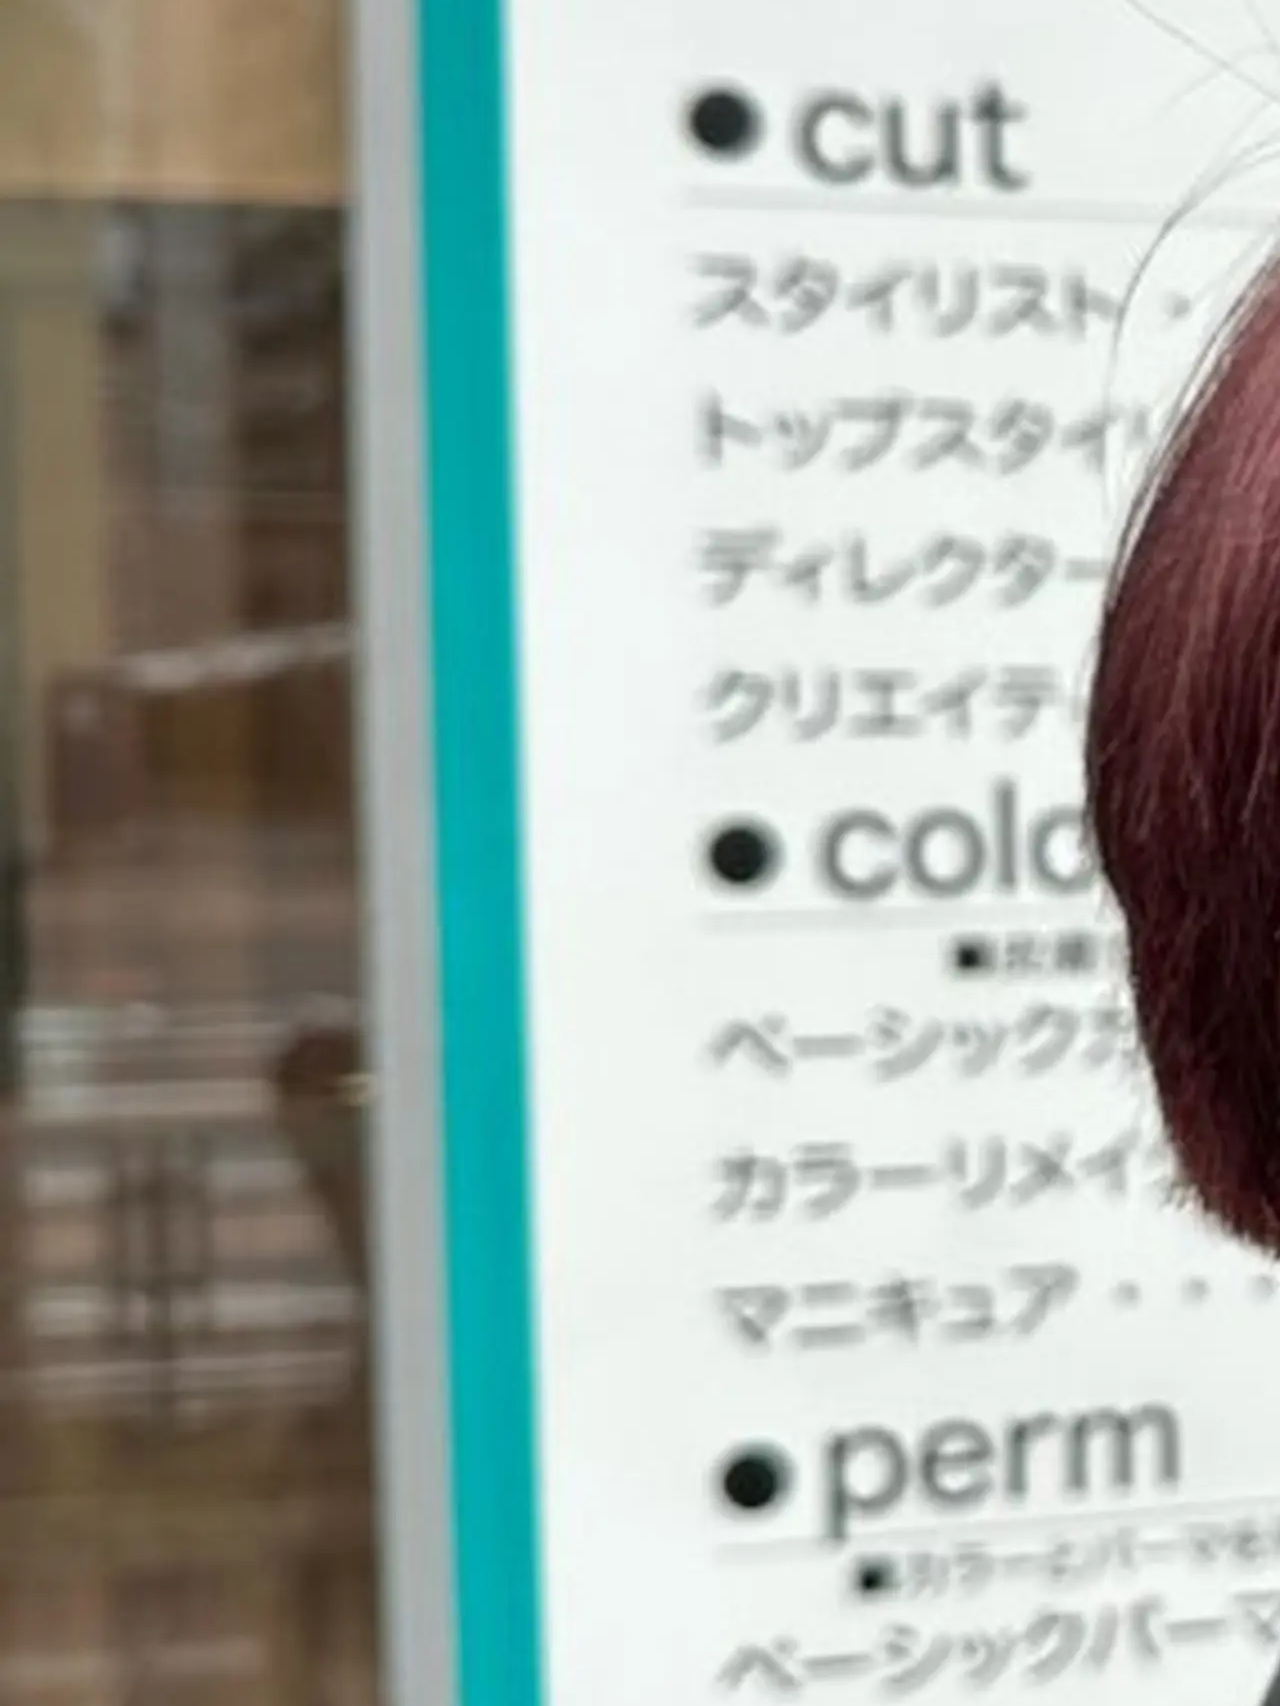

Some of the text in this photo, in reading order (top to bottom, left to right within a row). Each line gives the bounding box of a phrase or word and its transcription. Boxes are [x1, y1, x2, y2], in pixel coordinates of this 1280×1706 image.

[796, 78, 1032, 193] cut
[690, 253, 1120, 339] スタイリスト
[714, 1263, 1082, 1353] マニキュア
[823, 1400, 1186, 1545] perm
